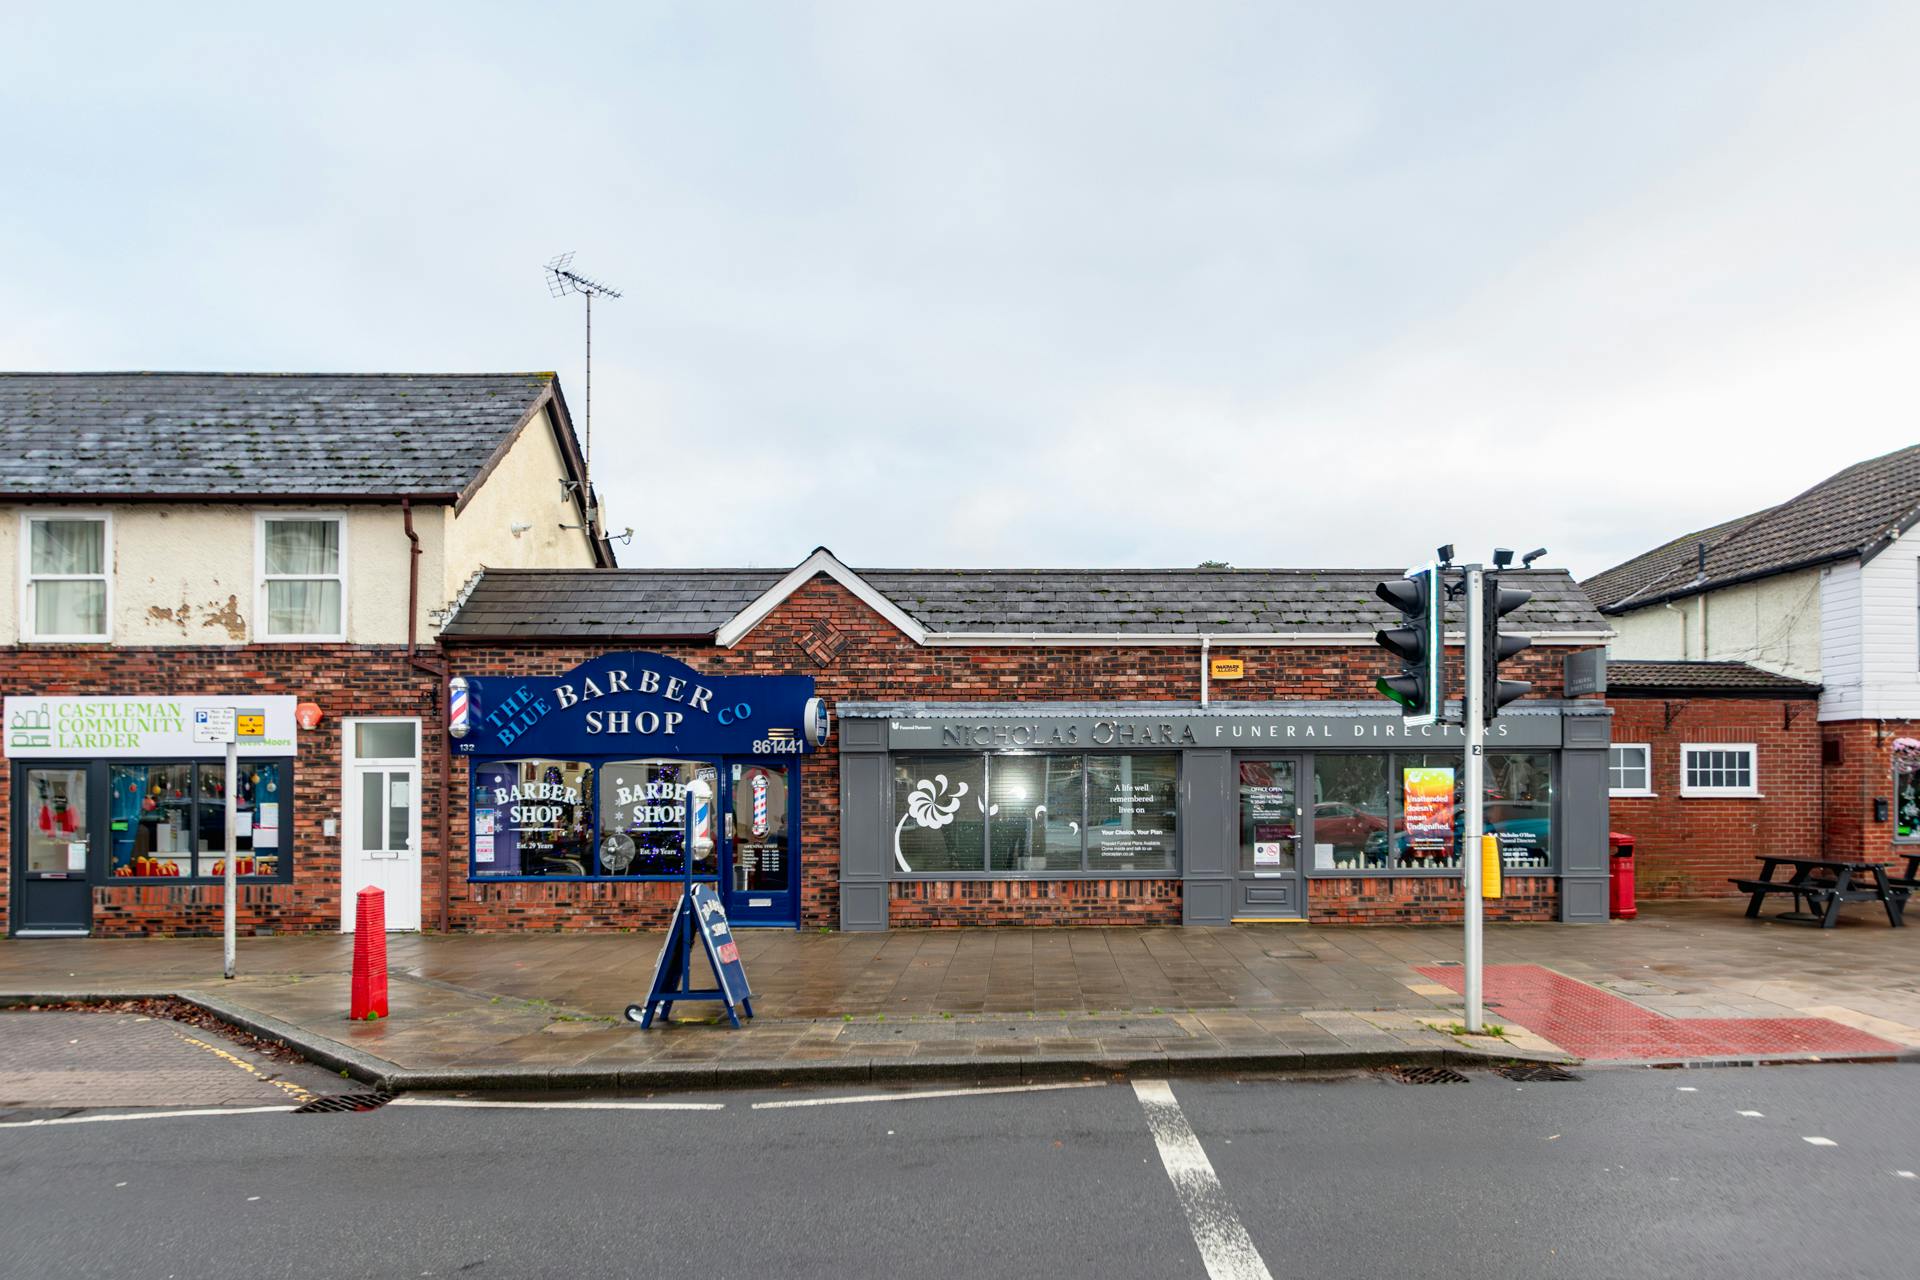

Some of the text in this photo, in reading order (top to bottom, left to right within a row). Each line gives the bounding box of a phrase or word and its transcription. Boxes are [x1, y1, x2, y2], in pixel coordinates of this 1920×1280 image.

[553, 669, 714, 714] BARBER
[58, 703, 183, 718] CASTLEMAN
[486, 685, 534, 728] THE
[717, 702, 752, 725] CO
[58, 718, 185, 733] COMMUNITY
[496, 697, 552, 747] BLUE
[585, 710, 684, 735] SHOP
[942, 720, 1197, 745] NICHOLAS O'HARA
[1215, 725, 1332, 737] FUNERAL
[58, 733, 140, 748] LARDER
[263, 738, 291, 746] Moors
[752, 739, 803, 754] 861441
[1474, 746, 1481, 754] 2
[493, 782, 578, 805] BARBER
[616, 782, 688, 805] BARBE
[510, 806, 563, 823] SHOP
[633, 805, 686, 823] SHOP
[1407, 823, 1450, 831] Undignified.
